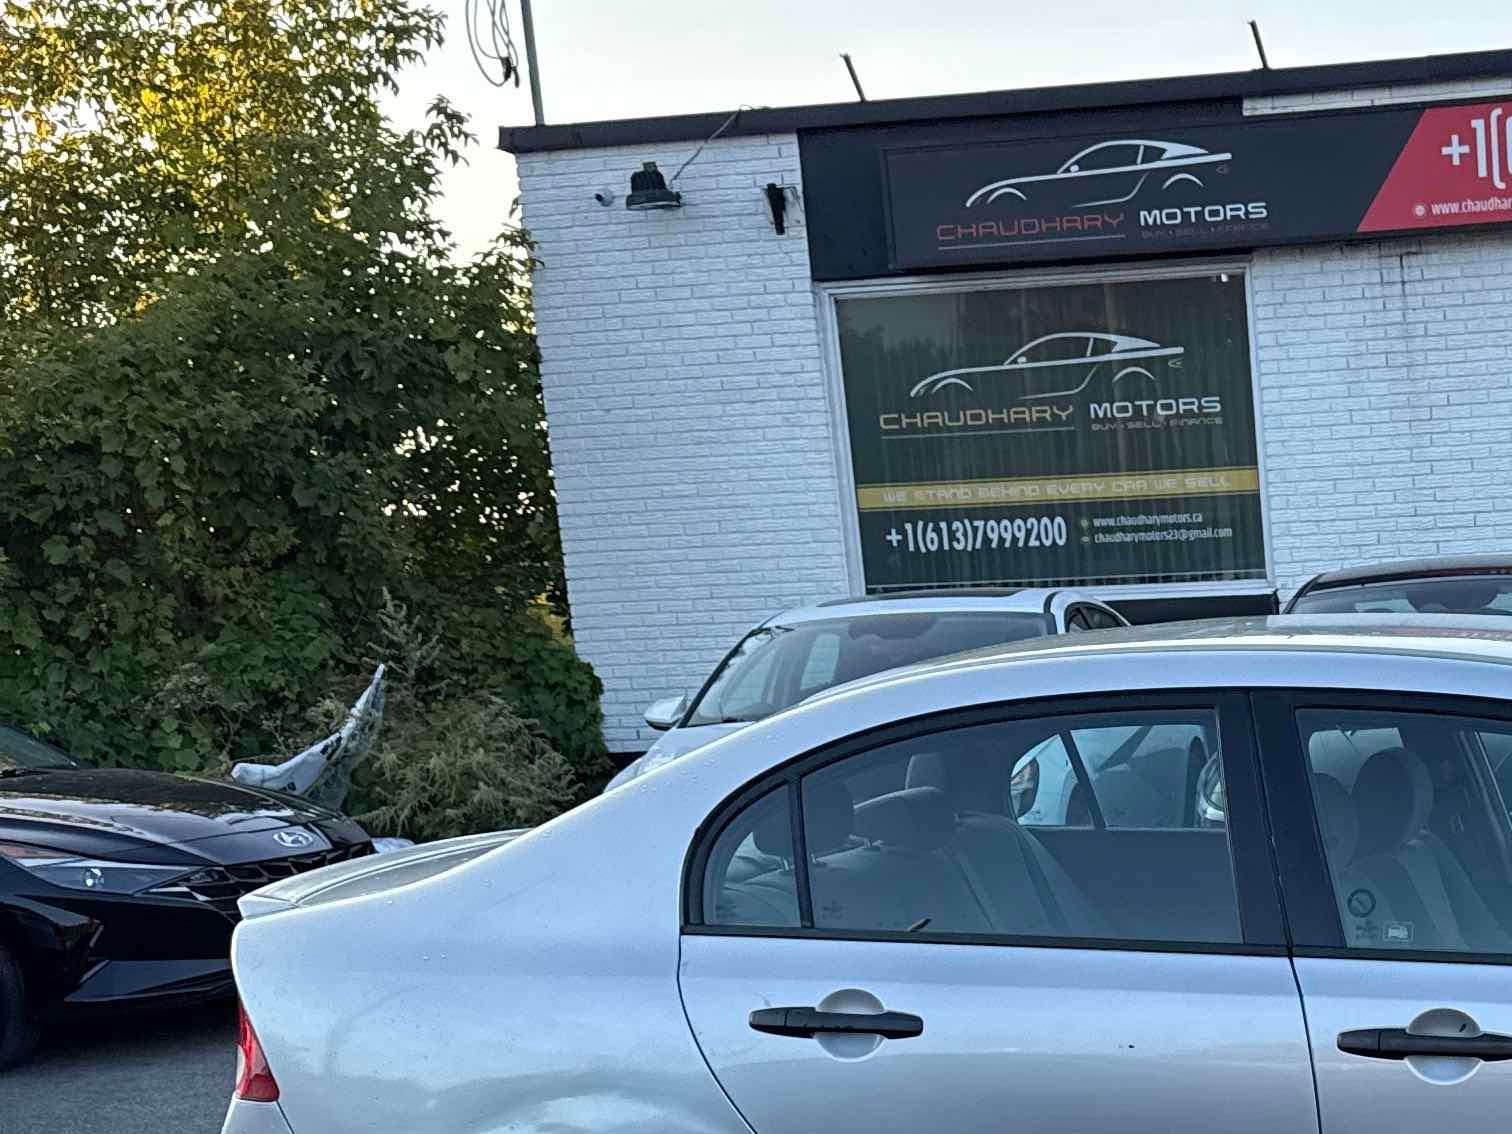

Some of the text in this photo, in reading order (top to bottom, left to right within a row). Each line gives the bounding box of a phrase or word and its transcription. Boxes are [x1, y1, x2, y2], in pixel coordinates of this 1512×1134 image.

[936, 212, 1125, 241] CHAUDHARY
[1139, 202, 1268, 227] MOTORS
[879, 396, 1222, 430] CHAUDHARY MOTORS
[886, 516, 1067, 553] +1(613)7999200
